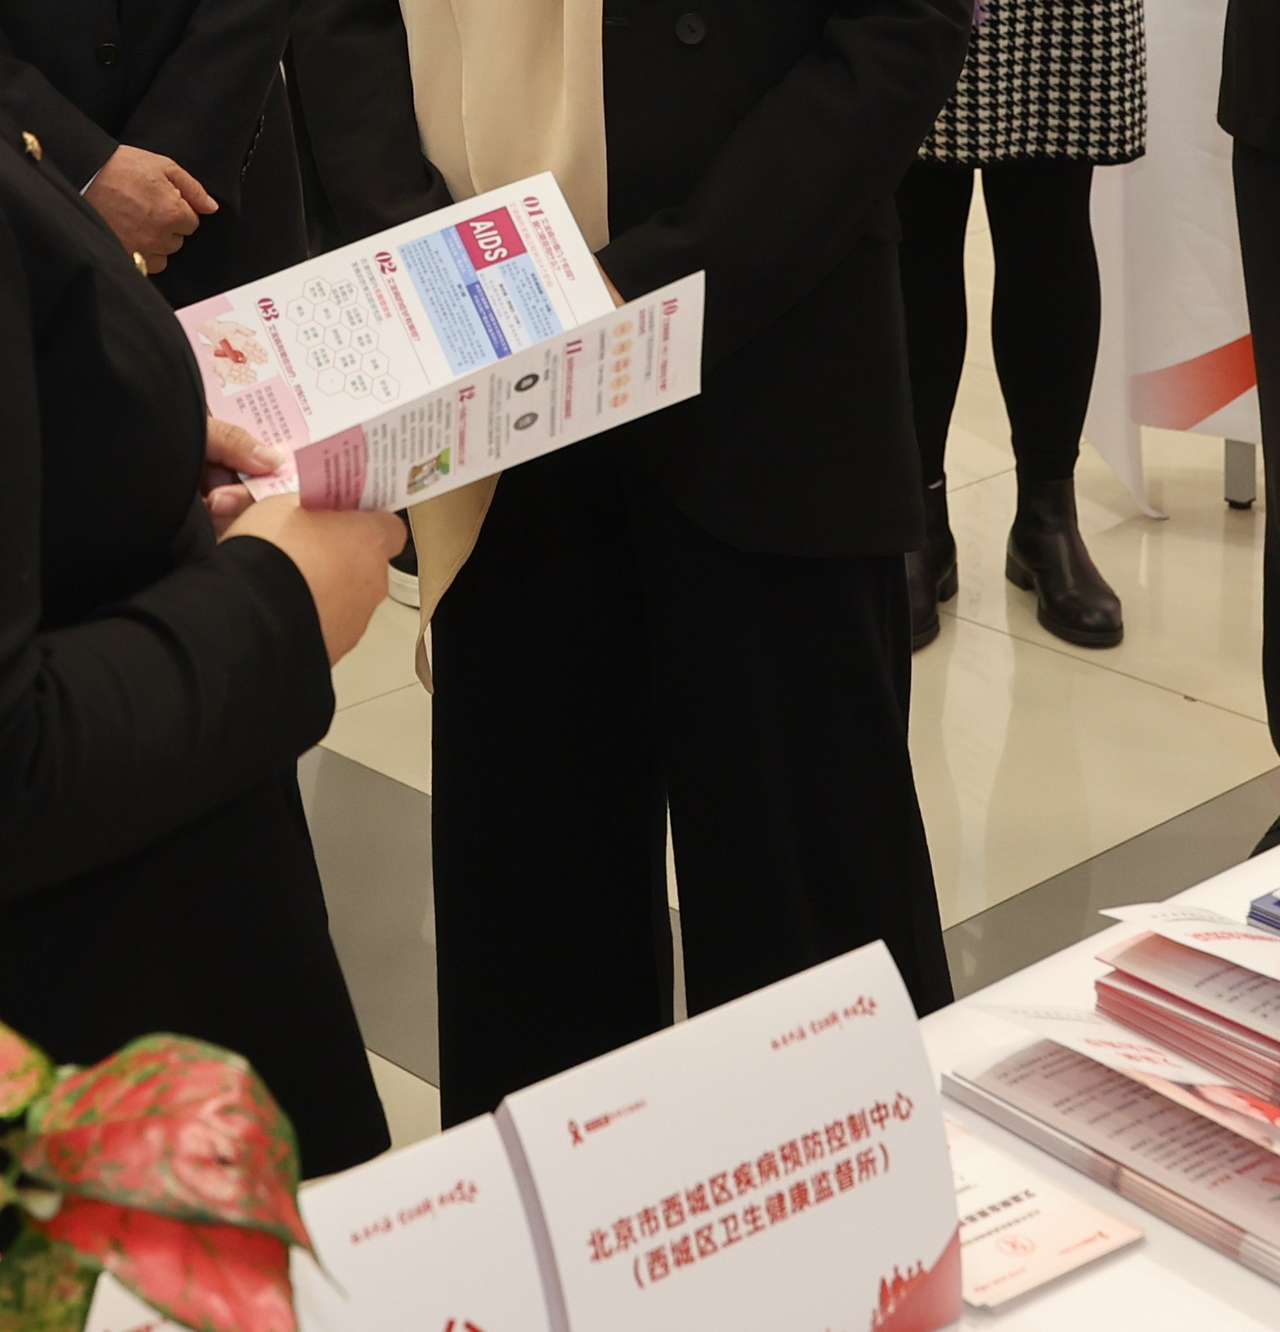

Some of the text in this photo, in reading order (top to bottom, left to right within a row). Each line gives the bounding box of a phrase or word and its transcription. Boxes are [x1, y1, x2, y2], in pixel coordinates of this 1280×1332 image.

[373, 248, 399, 277] 02
[468, 213, 510, 266] AIDS
[255, 295, 281, 324] 03
[586, 1090, 916, 1266] 北京市西城区疾病预防控制中心
[632, 1142, 892, 1290] （西城区卫生健康监督所）
